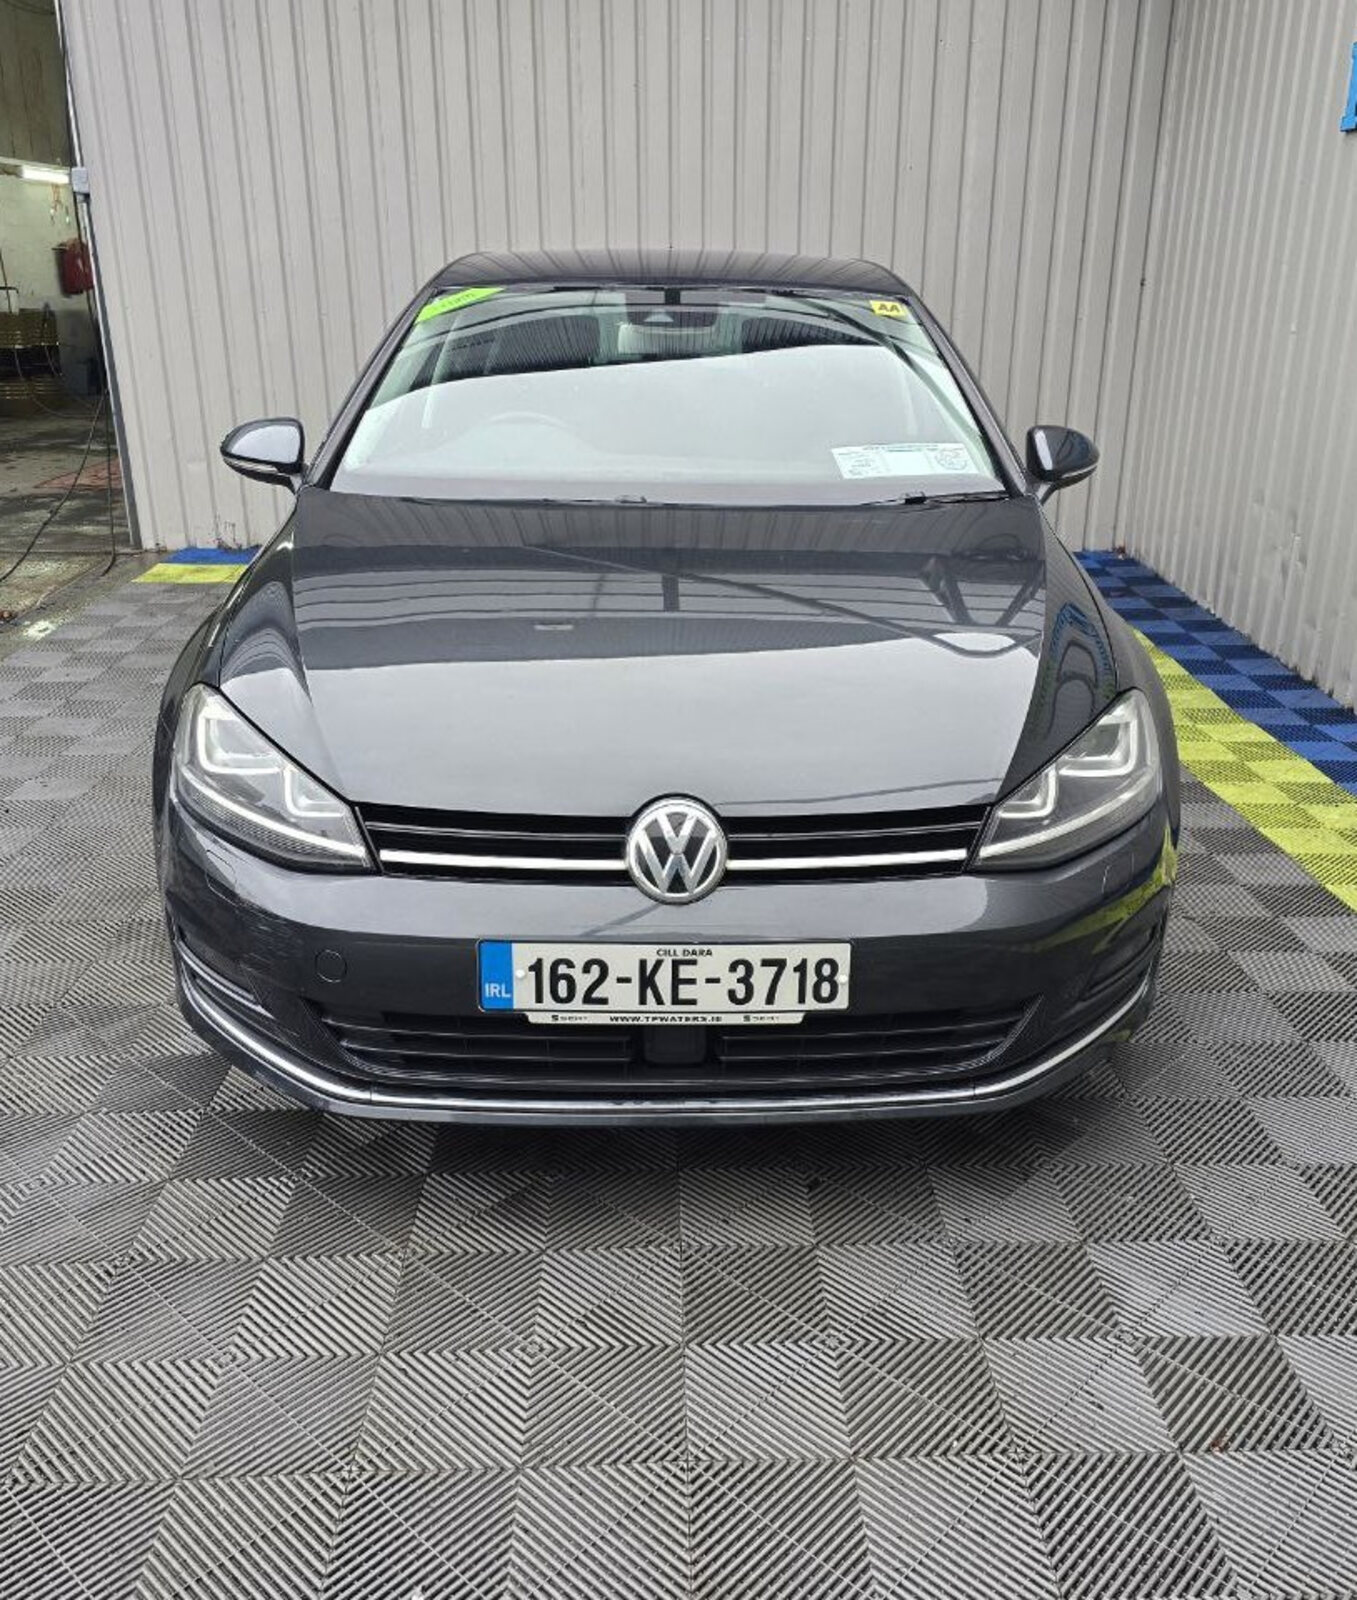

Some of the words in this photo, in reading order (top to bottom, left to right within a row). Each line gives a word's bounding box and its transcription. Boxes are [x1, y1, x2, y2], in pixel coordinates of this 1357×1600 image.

[878, 302, 900, 313] AA
[656, 947, 679, 957] CILL
[682, 947, 713, 957] DARA
[527, 957, 840, 1006] 162-KE-3718
[484, 982, 512, 998] IRL
